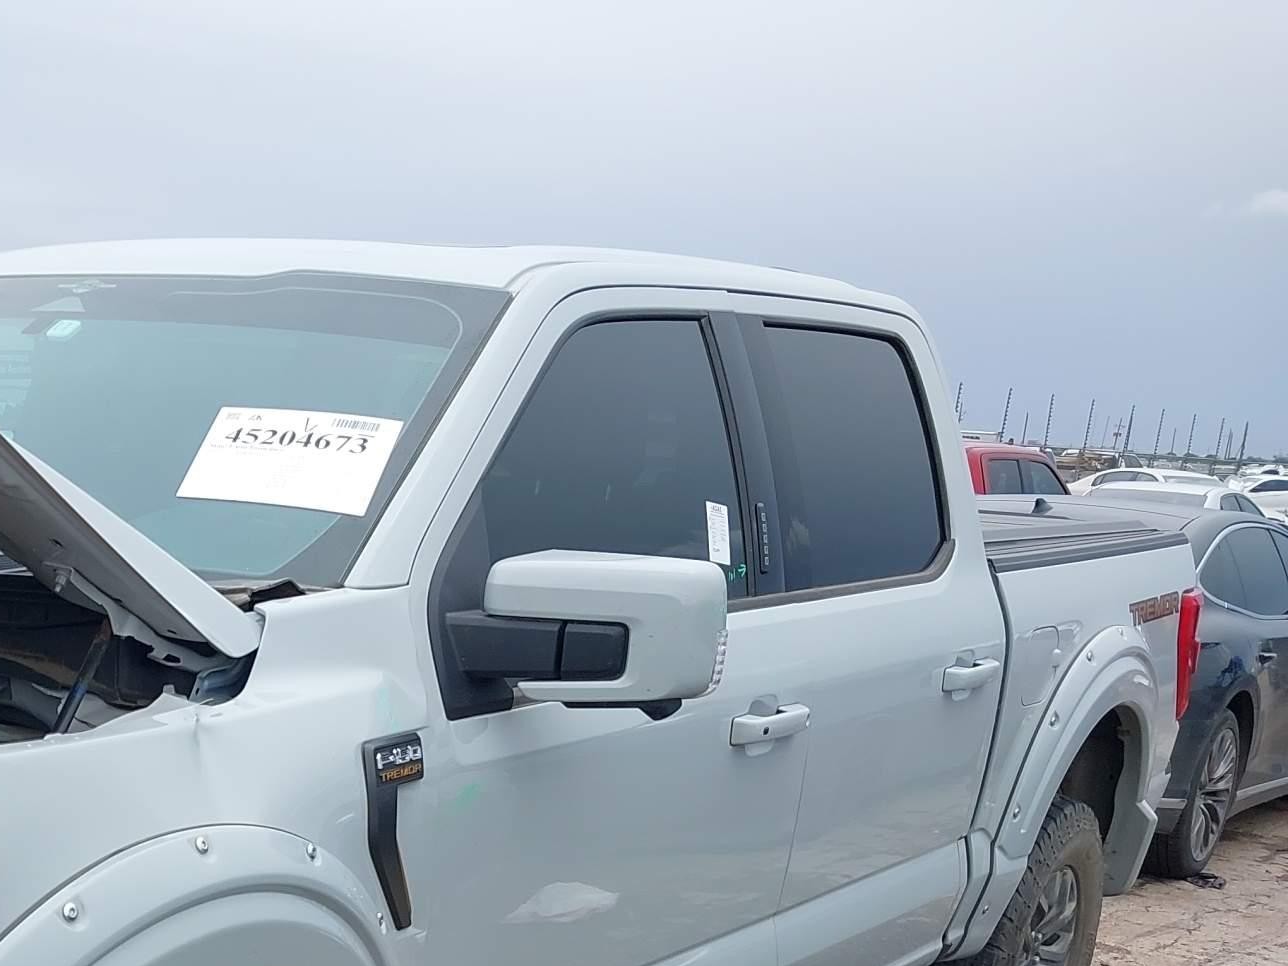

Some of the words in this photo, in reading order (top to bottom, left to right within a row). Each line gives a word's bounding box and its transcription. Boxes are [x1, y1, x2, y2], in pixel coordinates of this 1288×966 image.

[225, 427, 370, 454] 45204673
[1128, 591, 1180, 627] TREMOR
[379, 763, 422, 782] TREMOR
